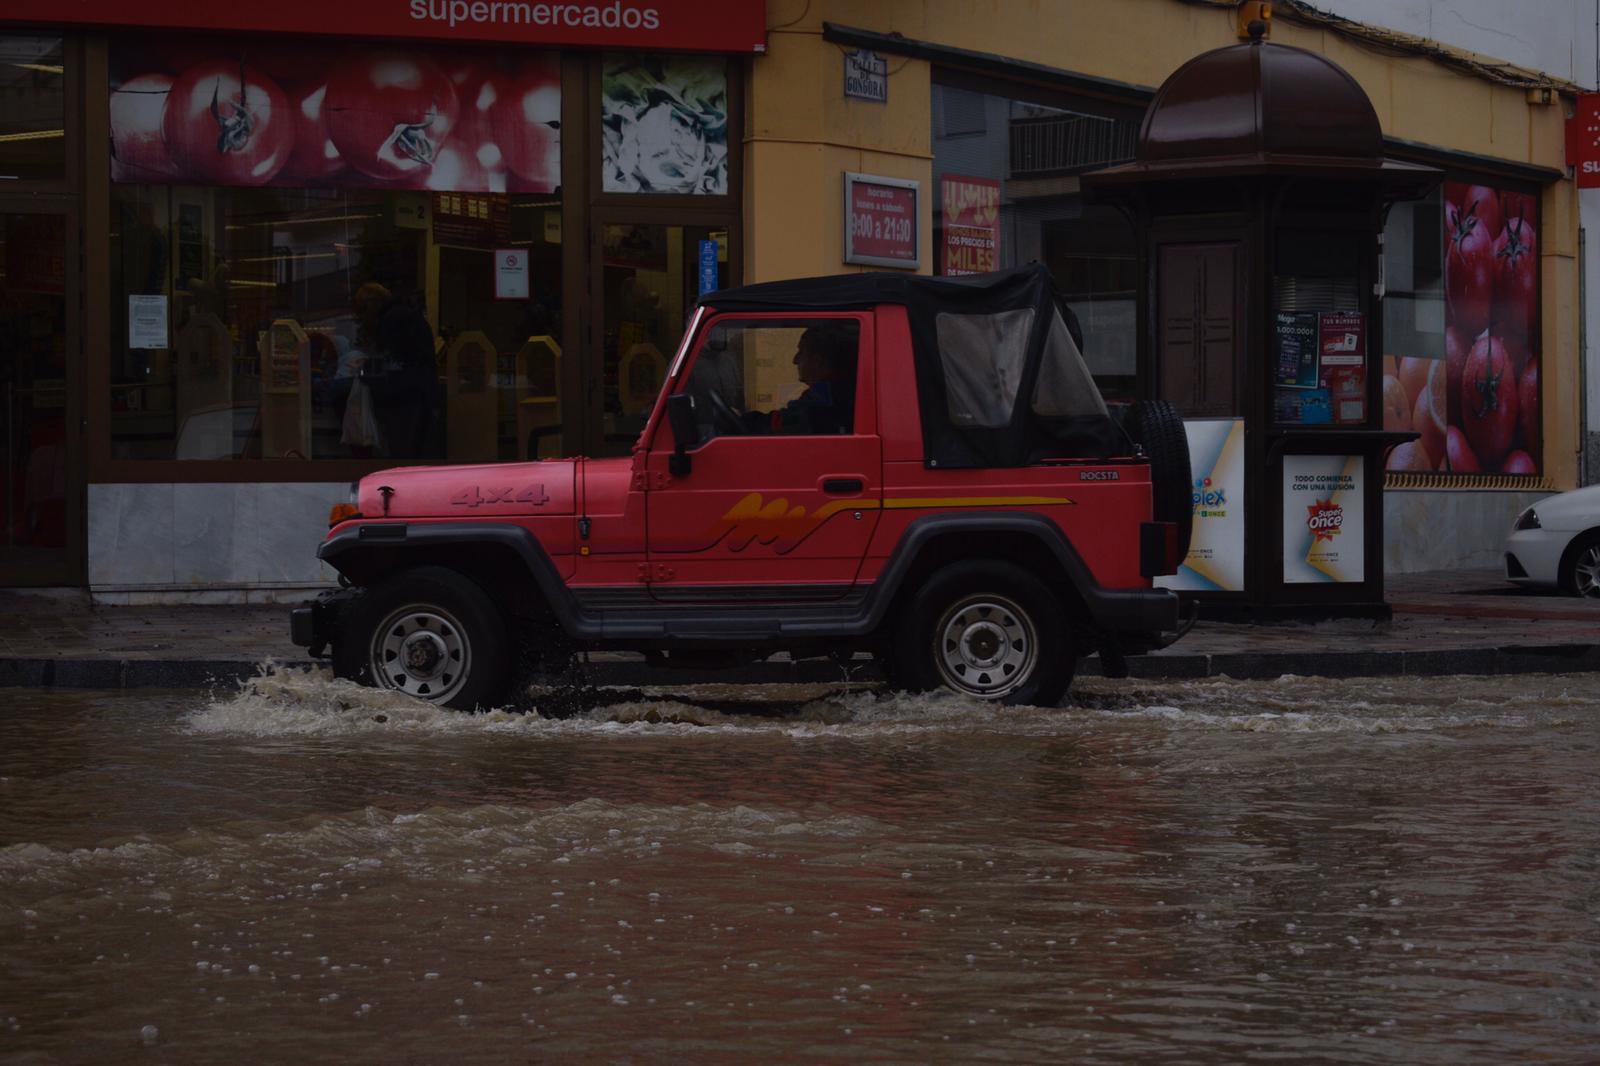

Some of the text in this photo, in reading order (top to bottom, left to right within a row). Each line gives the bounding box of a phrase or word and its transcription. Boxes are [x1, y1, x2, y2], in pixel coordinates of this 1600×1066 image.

[409, 0, 660, 29] supermercados
[875, 221, 881, 240] a
[883, 216, 911, 243] 21:30
[947, 236, 995, 249] LOS PRECIOS EN
[947, 246, 993, 272] MILES
[1080, 471, 1119, 480] ROCSTA
[1316, 475, 1353, 483] COMIENZA
[1292, 482, 1355, 491] CON UNA ILUSIÓN
[1318, 508, 1343, 519] Super
[1309, 515, 1343, 529] Once
